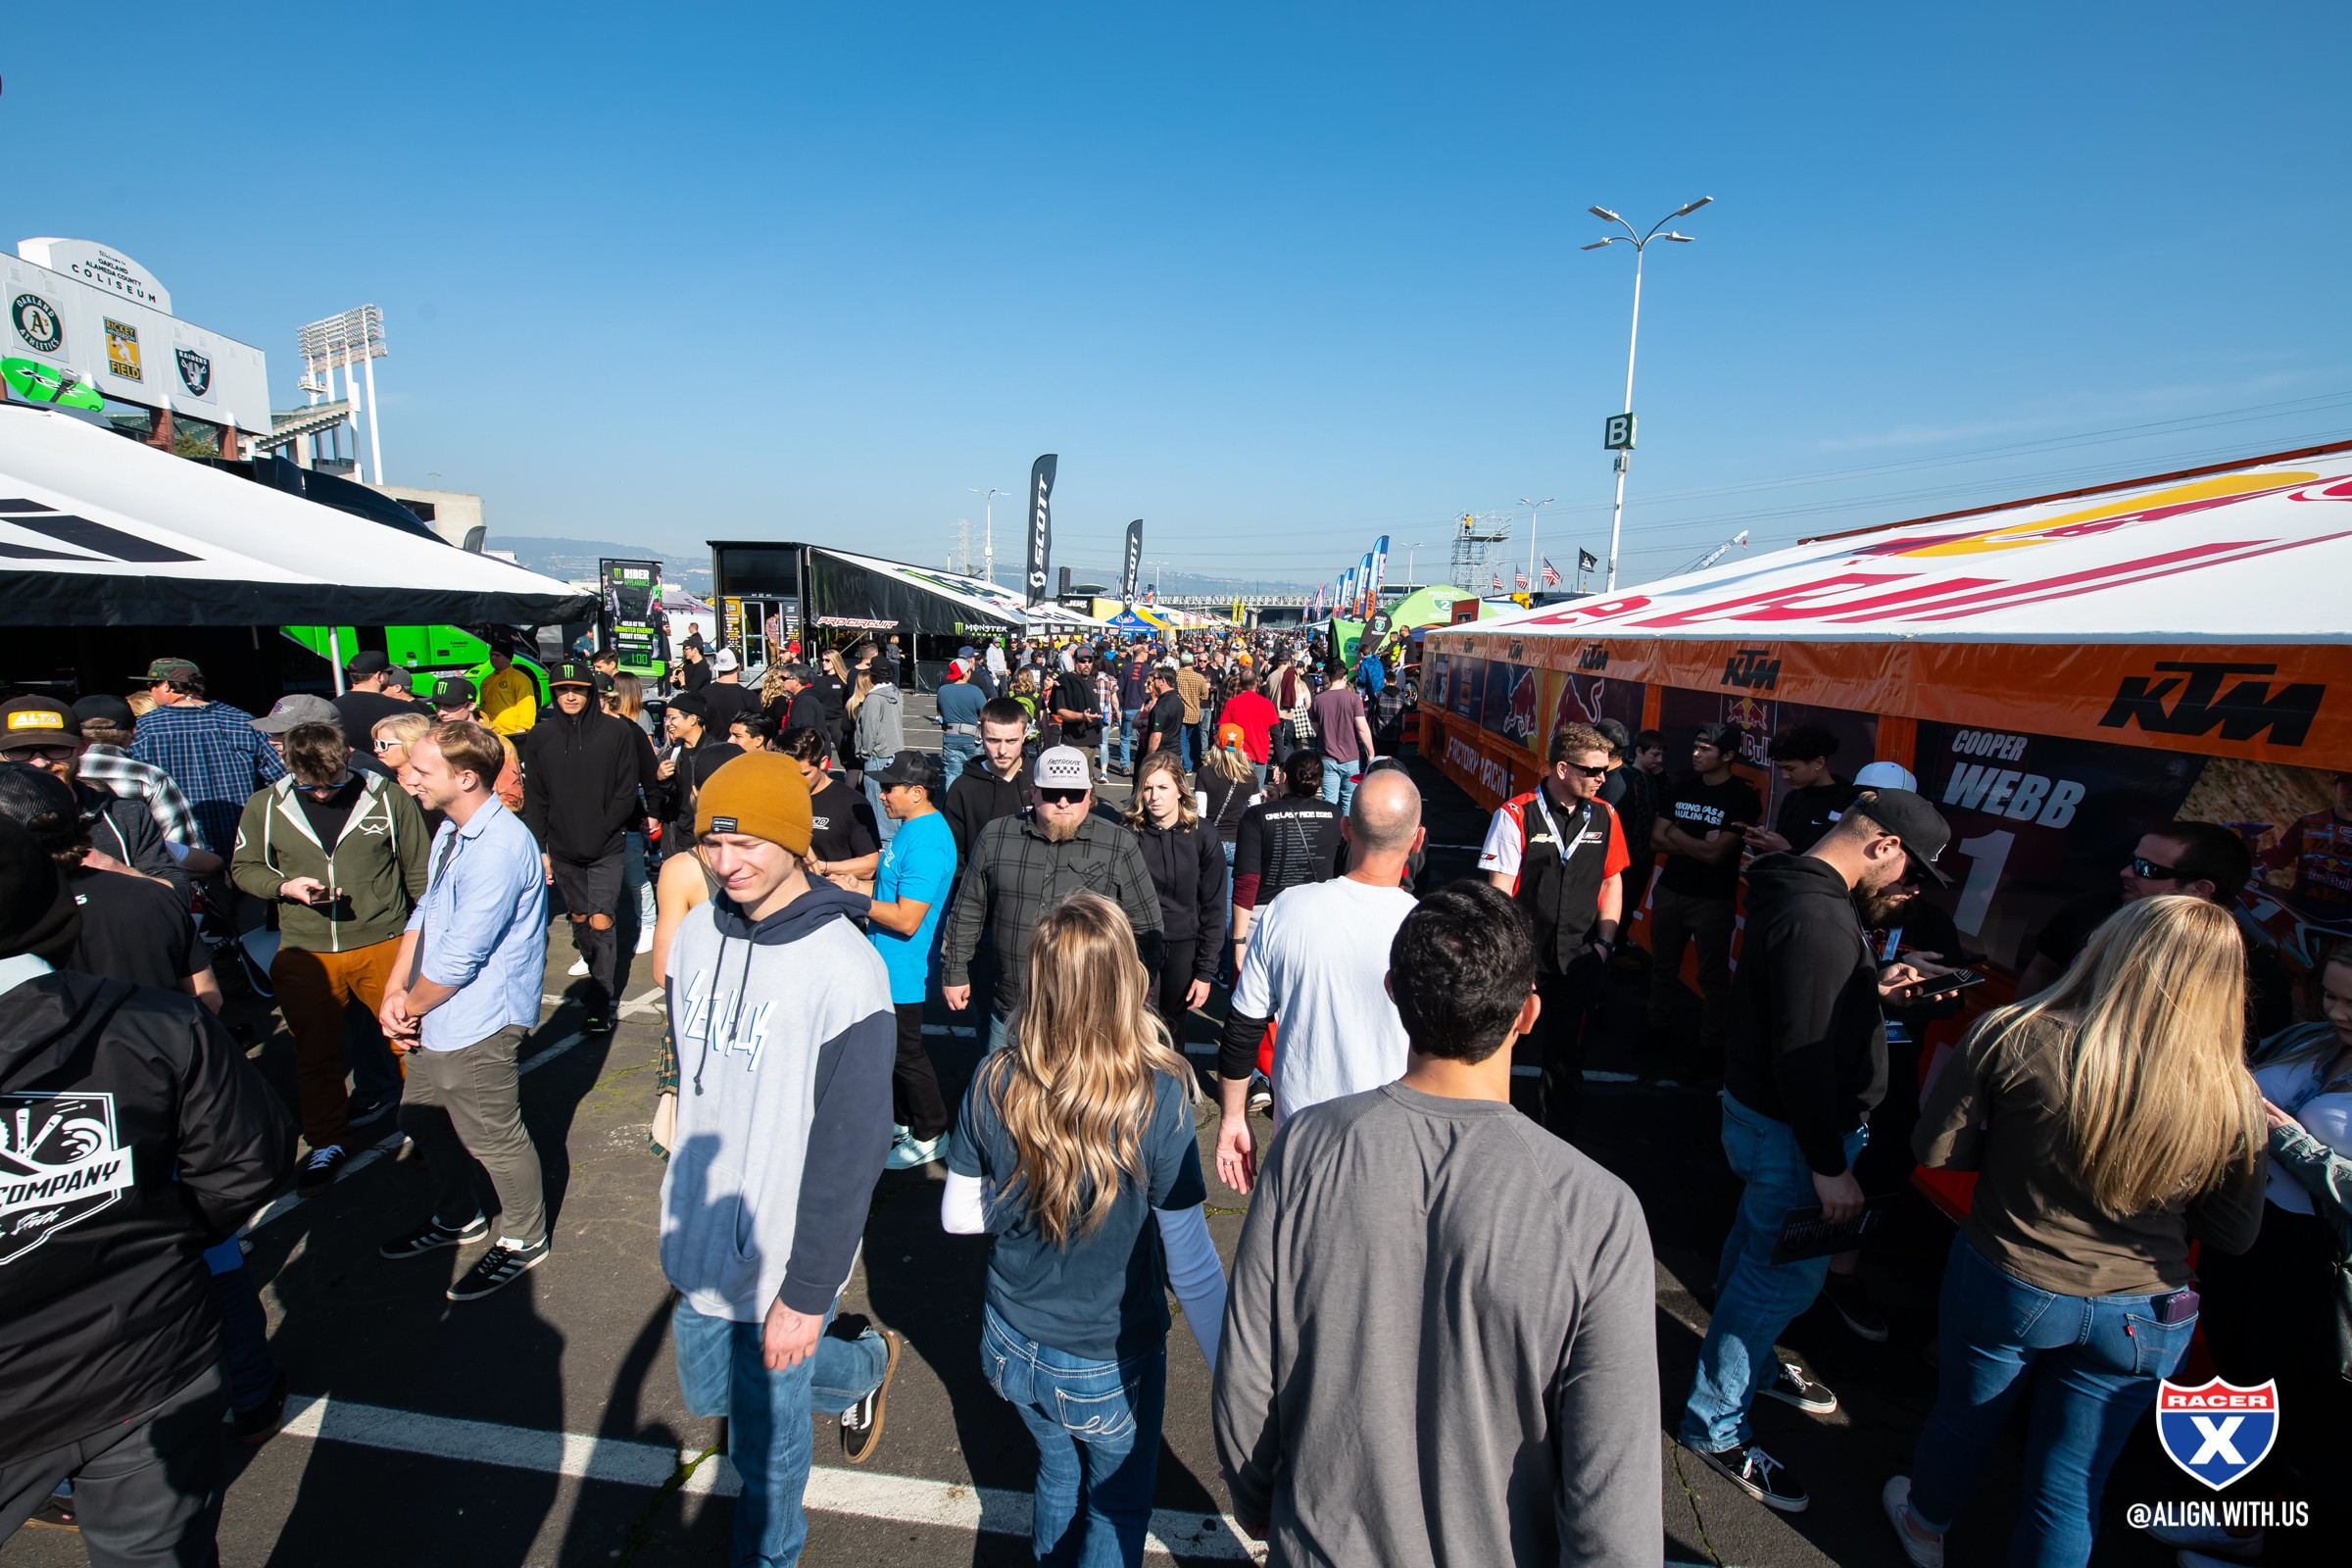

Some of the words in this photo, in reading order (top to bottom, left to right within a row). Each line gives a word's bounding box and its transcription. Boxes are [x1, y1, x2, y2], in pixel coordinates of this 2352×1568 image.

[85, 260, 116, 277] ALAMEDA
[117, 273, 142, 287] COUNTY
[98, 258, 128, 274] OAKLAND
[72, 264, 157, 303] COLISEUM
[16, 295, 55, 318] OAKLAND
[106, 319, 134, 336] RICKEY
[19, 328, 60, 351] ATHLETICS
[178, 350, 208, 366] RAIDERS
[111, 361, 140, 379] FIELD
[1609, 417, 1628, 446] B
[1034, 472, 1048, 569] SCOTT
[623, 568, 650, 580] RIDER
[1127, 533, 1138, 593] SCOTT
[1440, 600, 1450, 611] 2
[816, 616, 847, 627] PRO
[845, 617, 899, 630] CIRCUIT
[964, 623, 1008, 633] MONSTER
[1508, 640, 1523, 660] KTM
[1578, 644, 1609, 670] KTM
[1721, 650, 1781, 691] KTM
[2097, 662, 2327, 747] KTM
[15, 712, 59, 722] ALTA
[1446, 735, 1480, 775] FACTORY
[1951, 728, 2028, 762] COOPER
[1940, 760, 2086, 830] WEBB
[1703, 814, 1723, 826] ASS
[1952, 828, 2014, 938] 1
